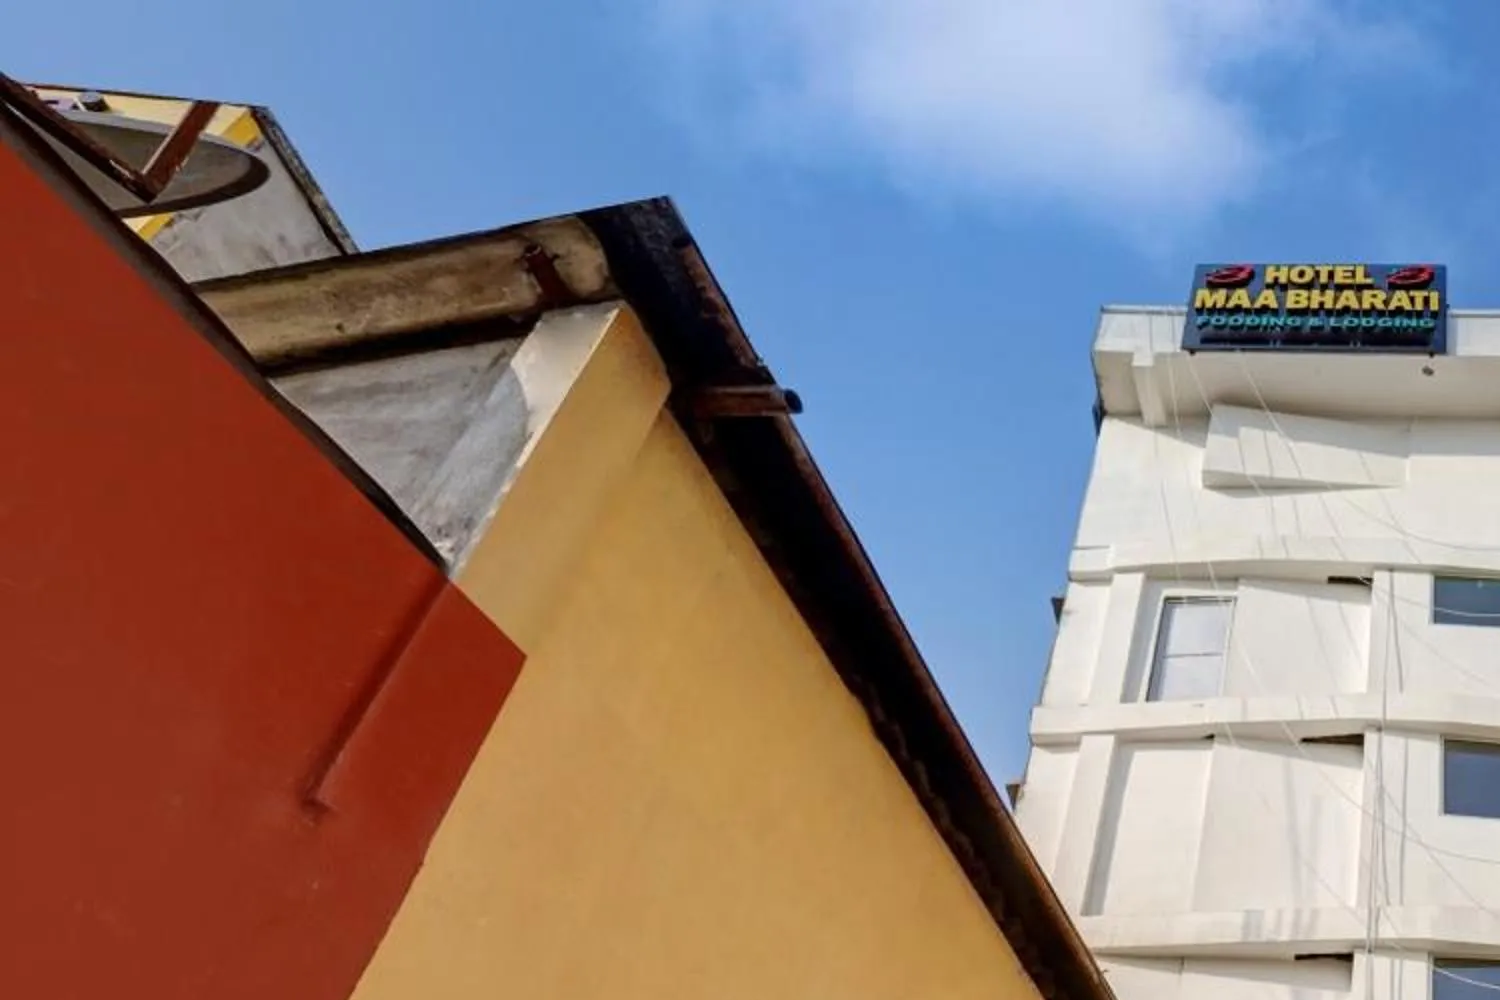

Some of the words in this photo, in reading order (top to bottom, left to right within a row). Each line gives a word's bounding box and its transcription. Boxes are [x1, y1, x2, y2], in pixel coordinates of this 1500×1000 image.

[1264, 265, 1374, 284] HOTEL
[1194, 288, 1278, 309] MAA
[1285, 289, 1439, 311] BHARATI
[1196, 315, 1301, 327] FOODING
[1307, 316, 1324, 327] &
[1329, 316, 1435, 328] LODGING
